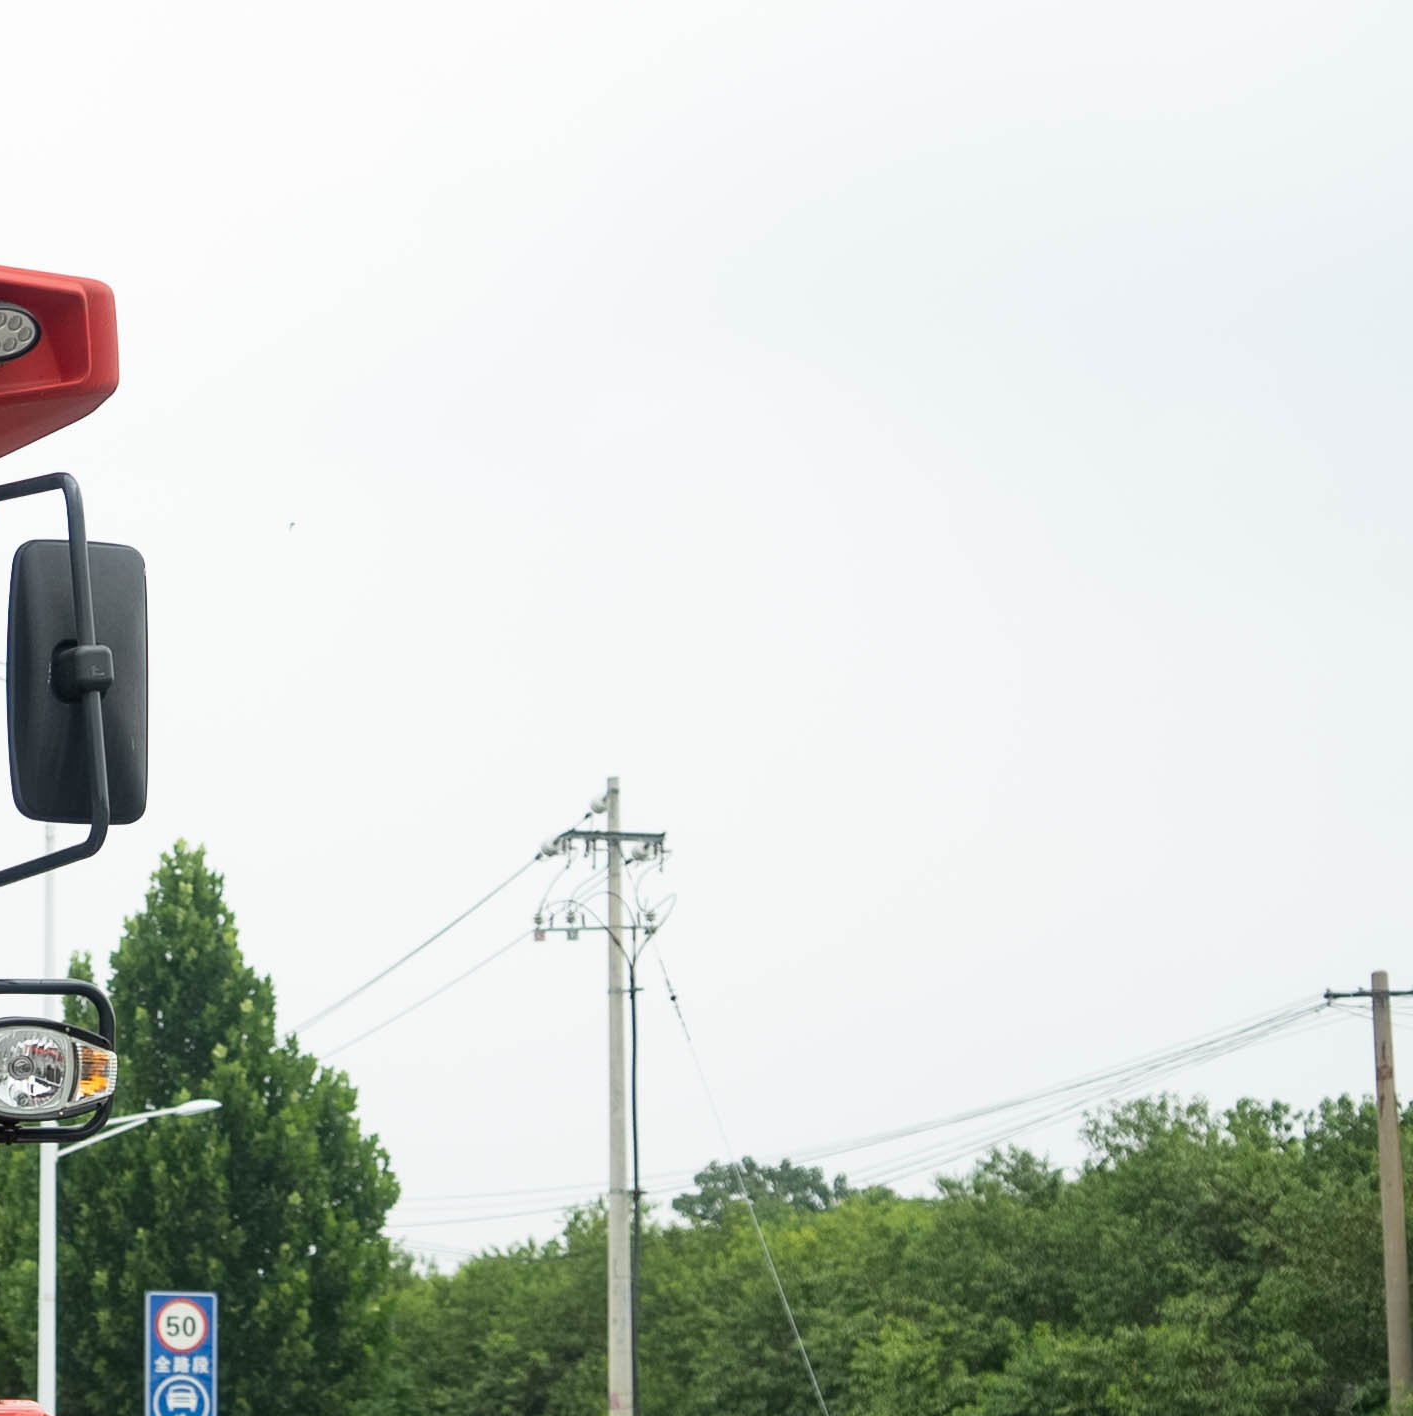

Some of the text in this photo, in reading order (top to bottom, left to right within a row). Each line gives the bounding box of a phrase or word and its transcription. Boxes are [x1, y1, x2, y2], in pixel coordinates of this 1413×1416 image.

[166, 1316, 196, 1336] 50
[154, 1355, 209, 1374] 全路段
